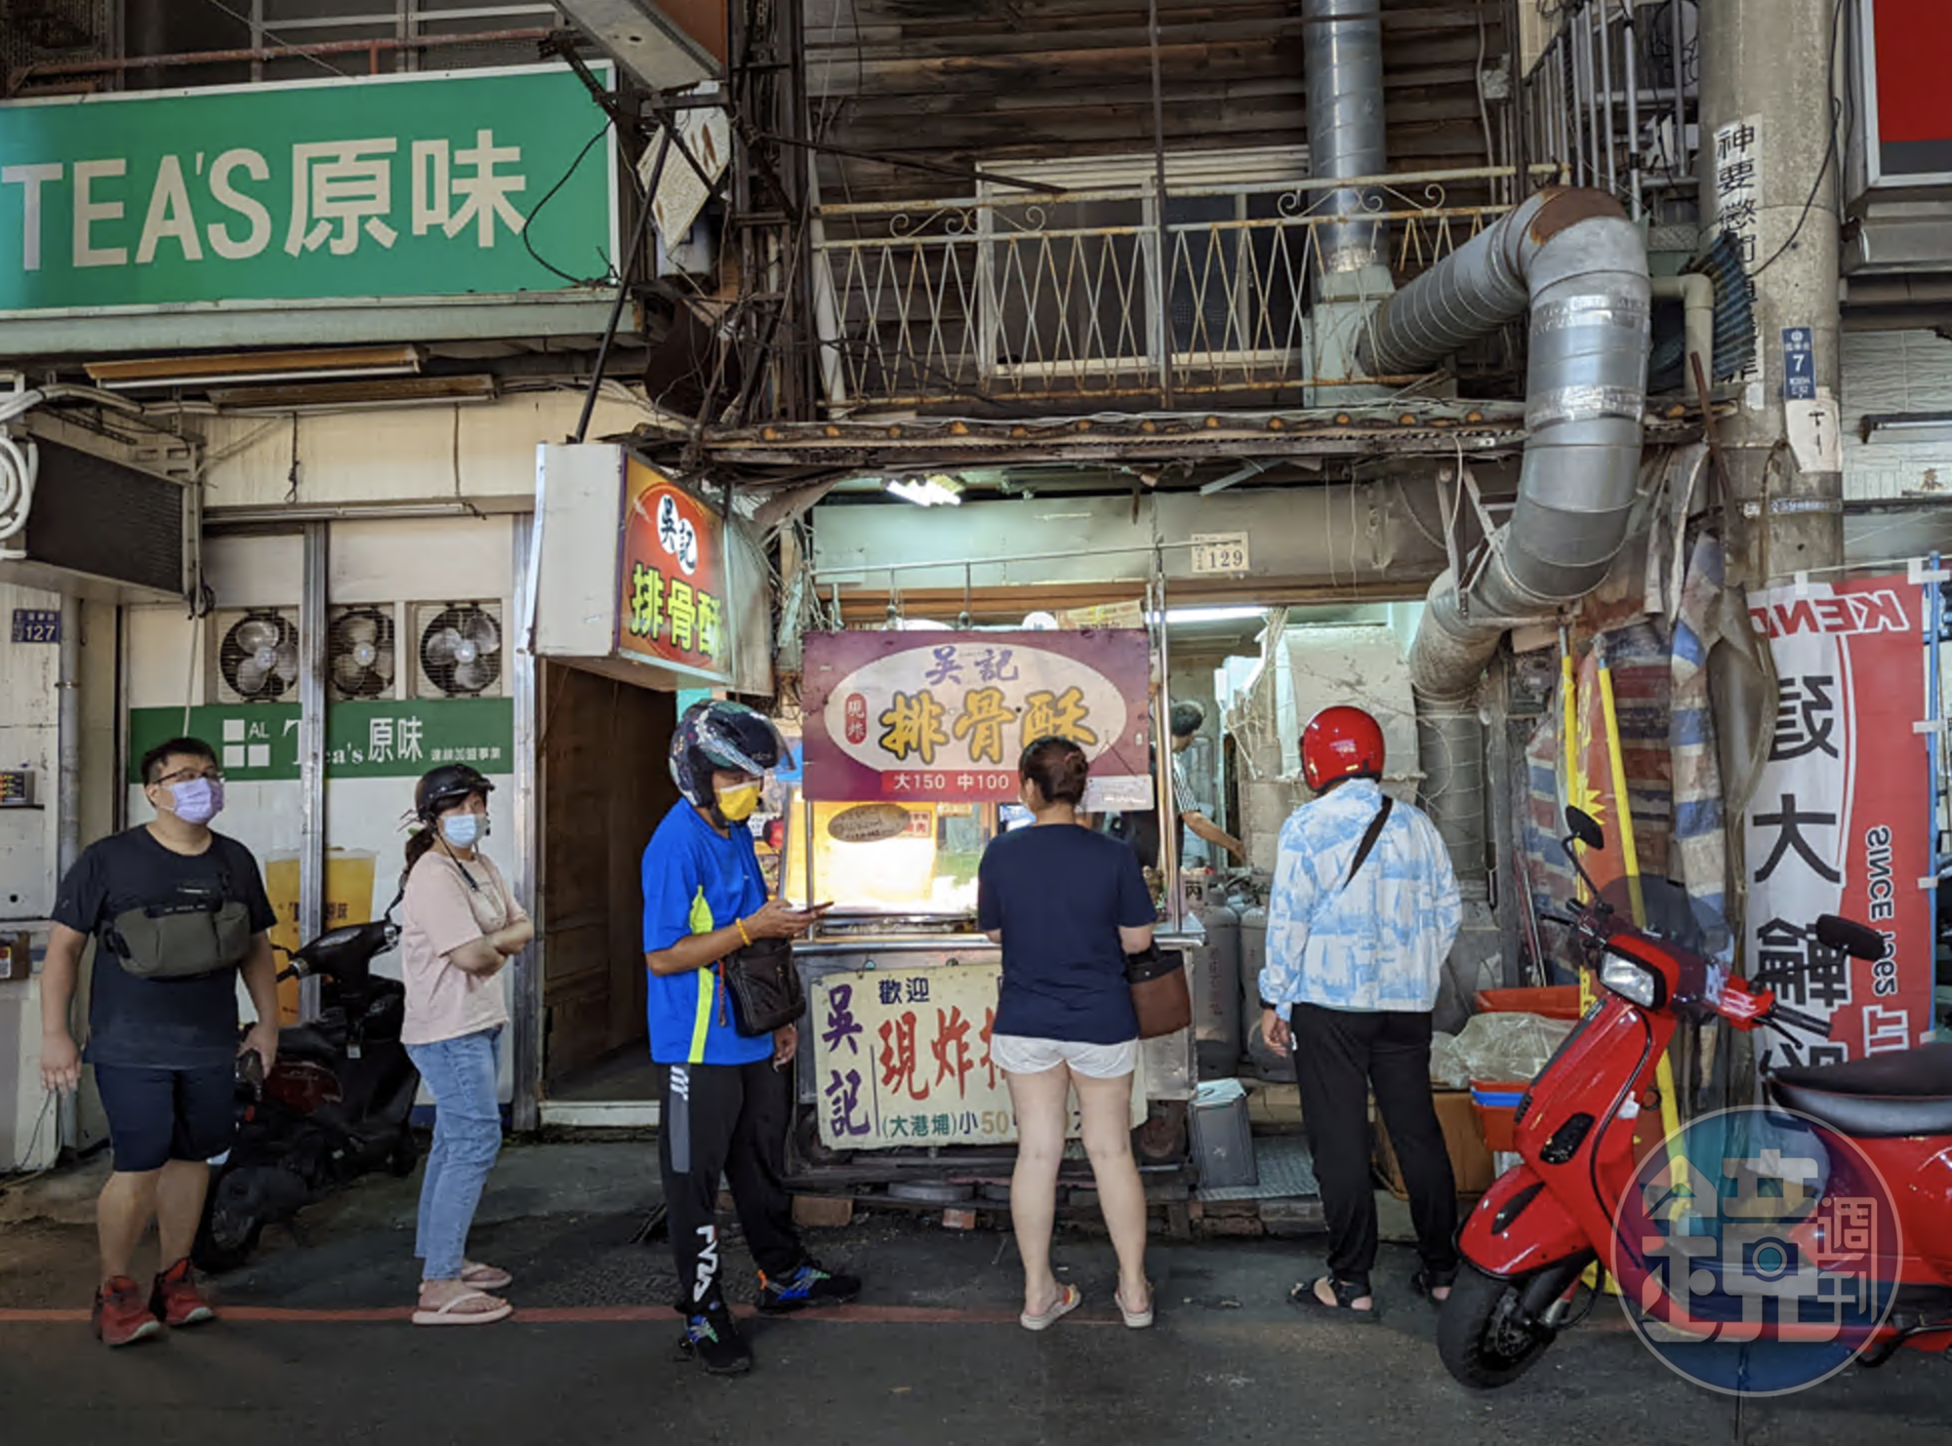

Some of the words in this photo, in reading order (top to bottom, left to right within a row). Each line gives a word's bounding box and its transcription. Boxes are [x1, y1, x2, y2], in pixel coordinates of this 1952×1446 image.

[2, 148, 271, 270] TEA'S
[285, 129, 527, 257] 原味
[1793, 353, 1805, 372] 7
[1208, 550, 1244, 569] 129
[26, 625, 56, 641] 127
[249, 722, 270, 739] AL
[879, 686, 1098, 765] 排骨酥
[368, 715, 423, 764] 原味
[893, 772, 945, 791] 大150
[957, 772, 1010, 791] 中100
[877, 977, 930, 1006] 歡迎
[820, 983, 870, 1138] 吳記
